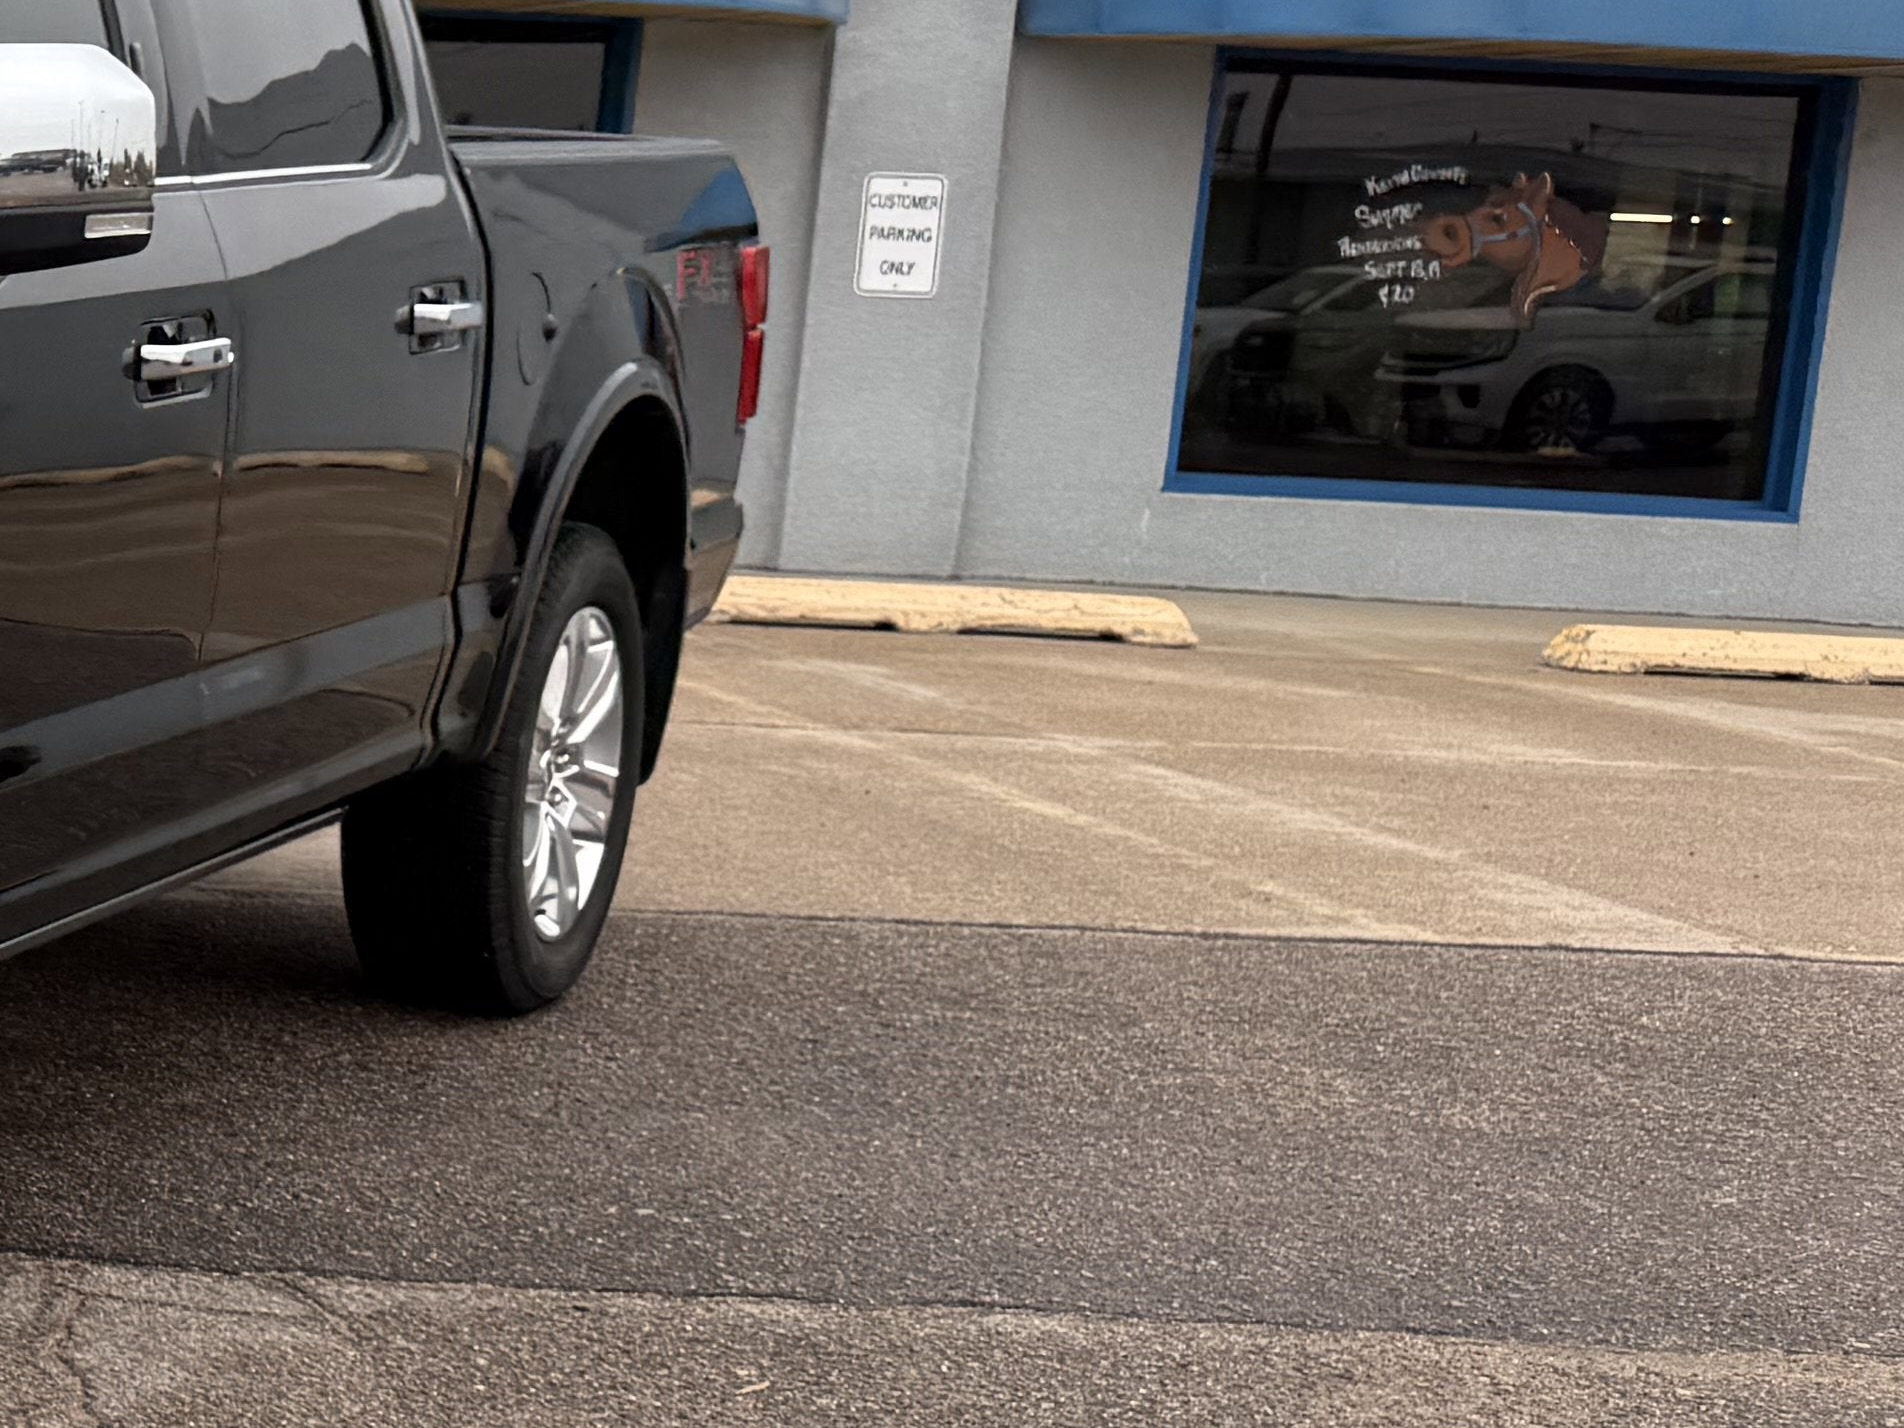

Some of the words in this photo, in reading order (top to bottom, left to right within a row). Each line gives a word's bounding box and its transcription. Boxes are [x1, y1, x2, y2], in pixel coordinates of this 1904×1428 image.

[869, 193, 938, 210] CUSTOMER
[869, 225, 933, 242] PARKING
[879, 260, 916, 276] ONLY
